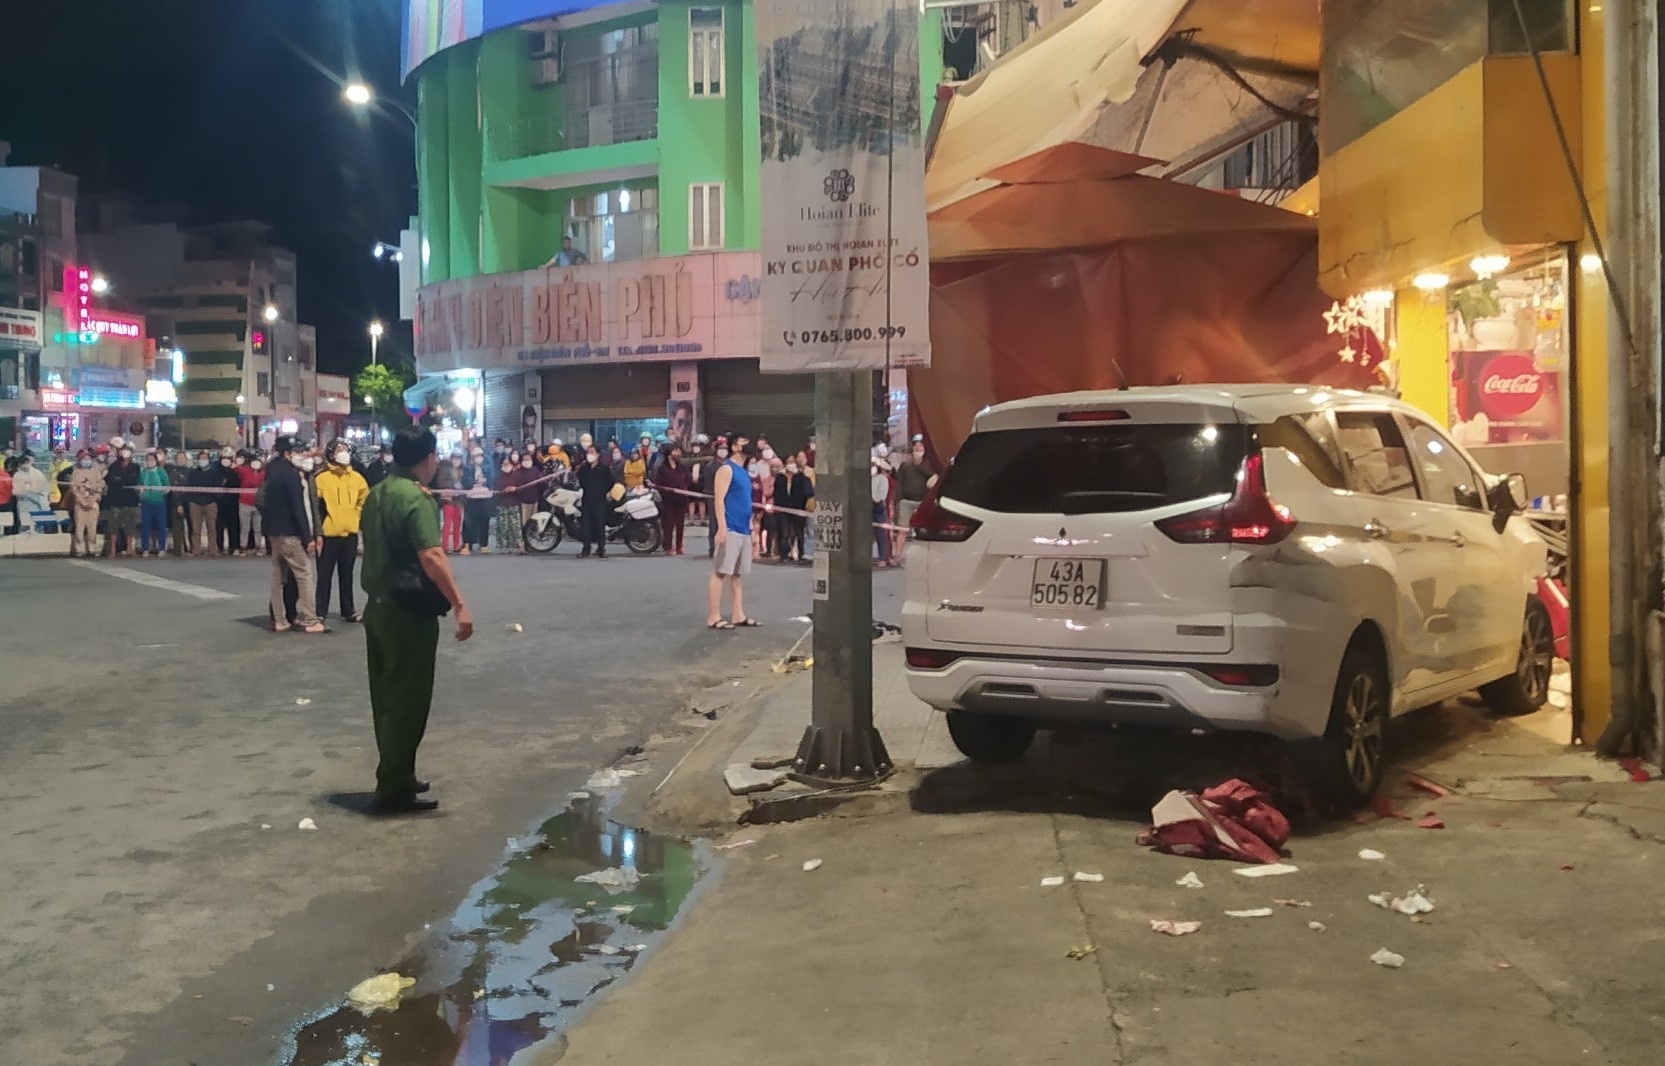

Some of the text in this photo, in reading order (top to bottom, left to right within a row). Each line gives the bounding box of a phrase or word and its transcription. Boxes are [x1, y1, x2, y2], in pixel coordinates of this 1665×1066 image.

[532, 269, 602, 344] BIÊN
[617, 262, 692, 340] PHỦ
[819, 501, 841, 511] VAY
[1050, 561, 1083, 581] 43A
